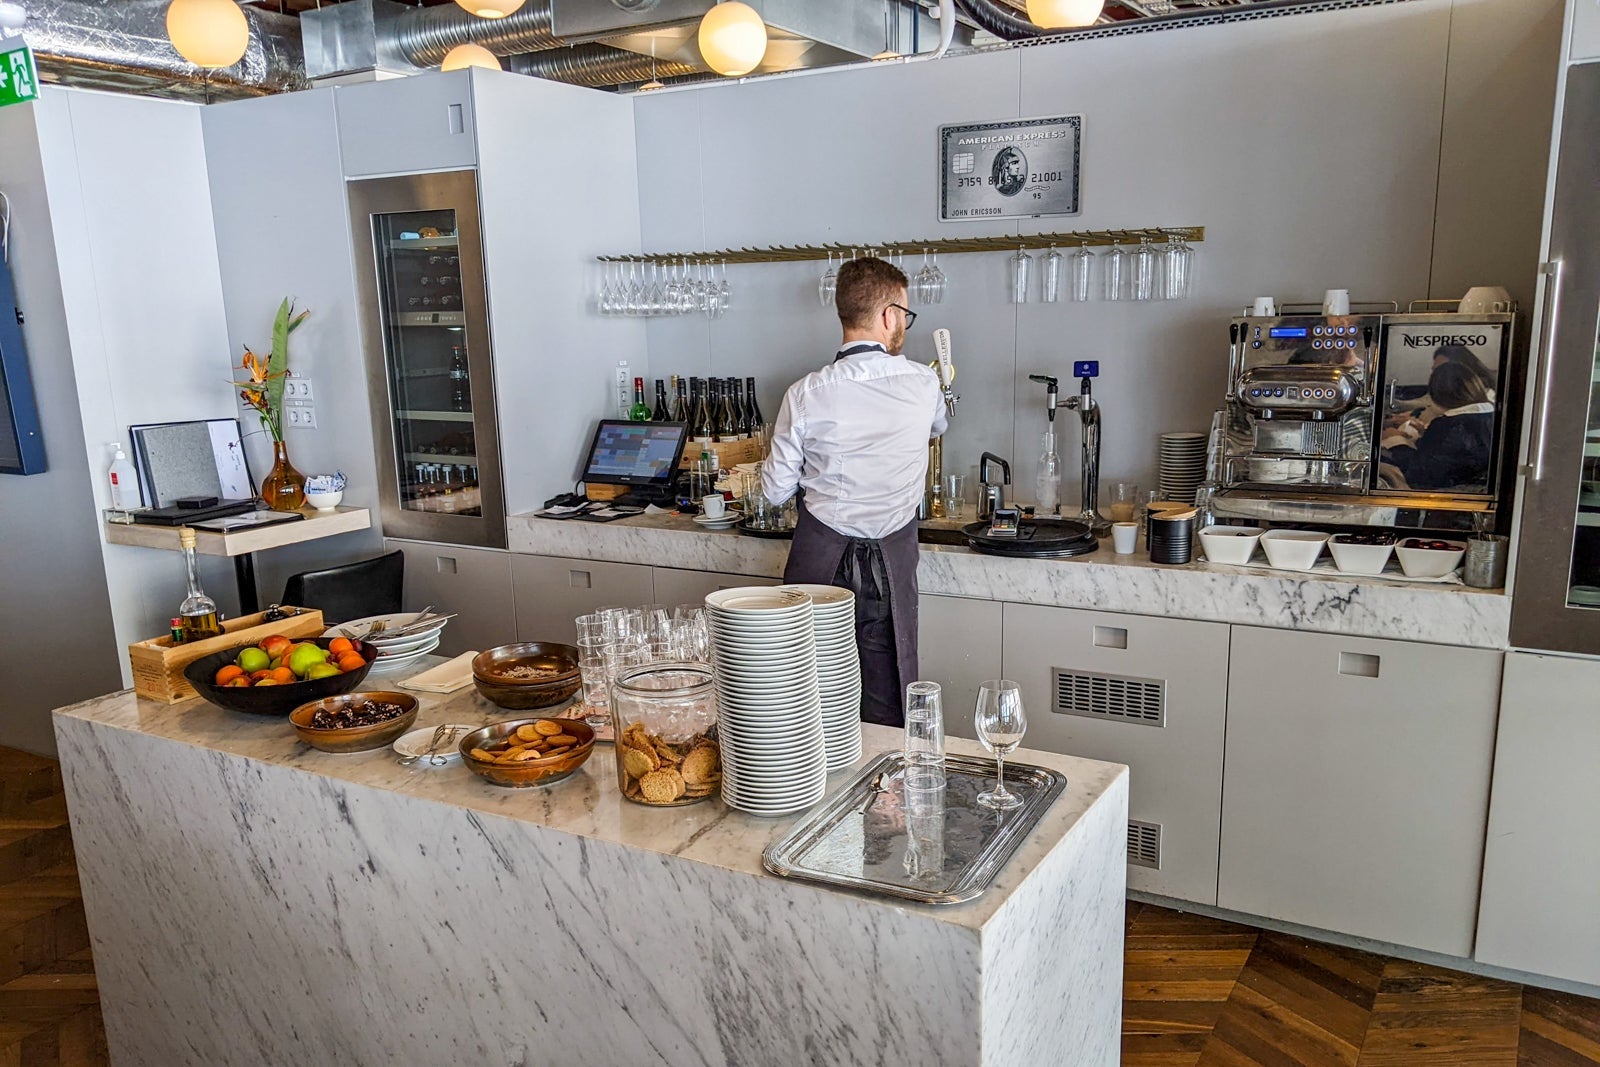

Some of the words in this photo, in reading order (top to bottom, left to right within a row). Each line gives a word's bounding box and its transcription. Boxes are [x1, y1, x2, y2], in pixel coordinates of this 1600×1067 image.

[958, 135, 1014, 145] AMERICAN
[1016, 130, 1066, 141] EXPRESS
[958, 176, 982, 187] 3759
[1031, 171, 1062, 183] 21001
[951, 209, 968, 217] JOHN
[970, 207, 1002, 215] ERICSSON
[1401, 333, 1487, 349] NESPRESSO
